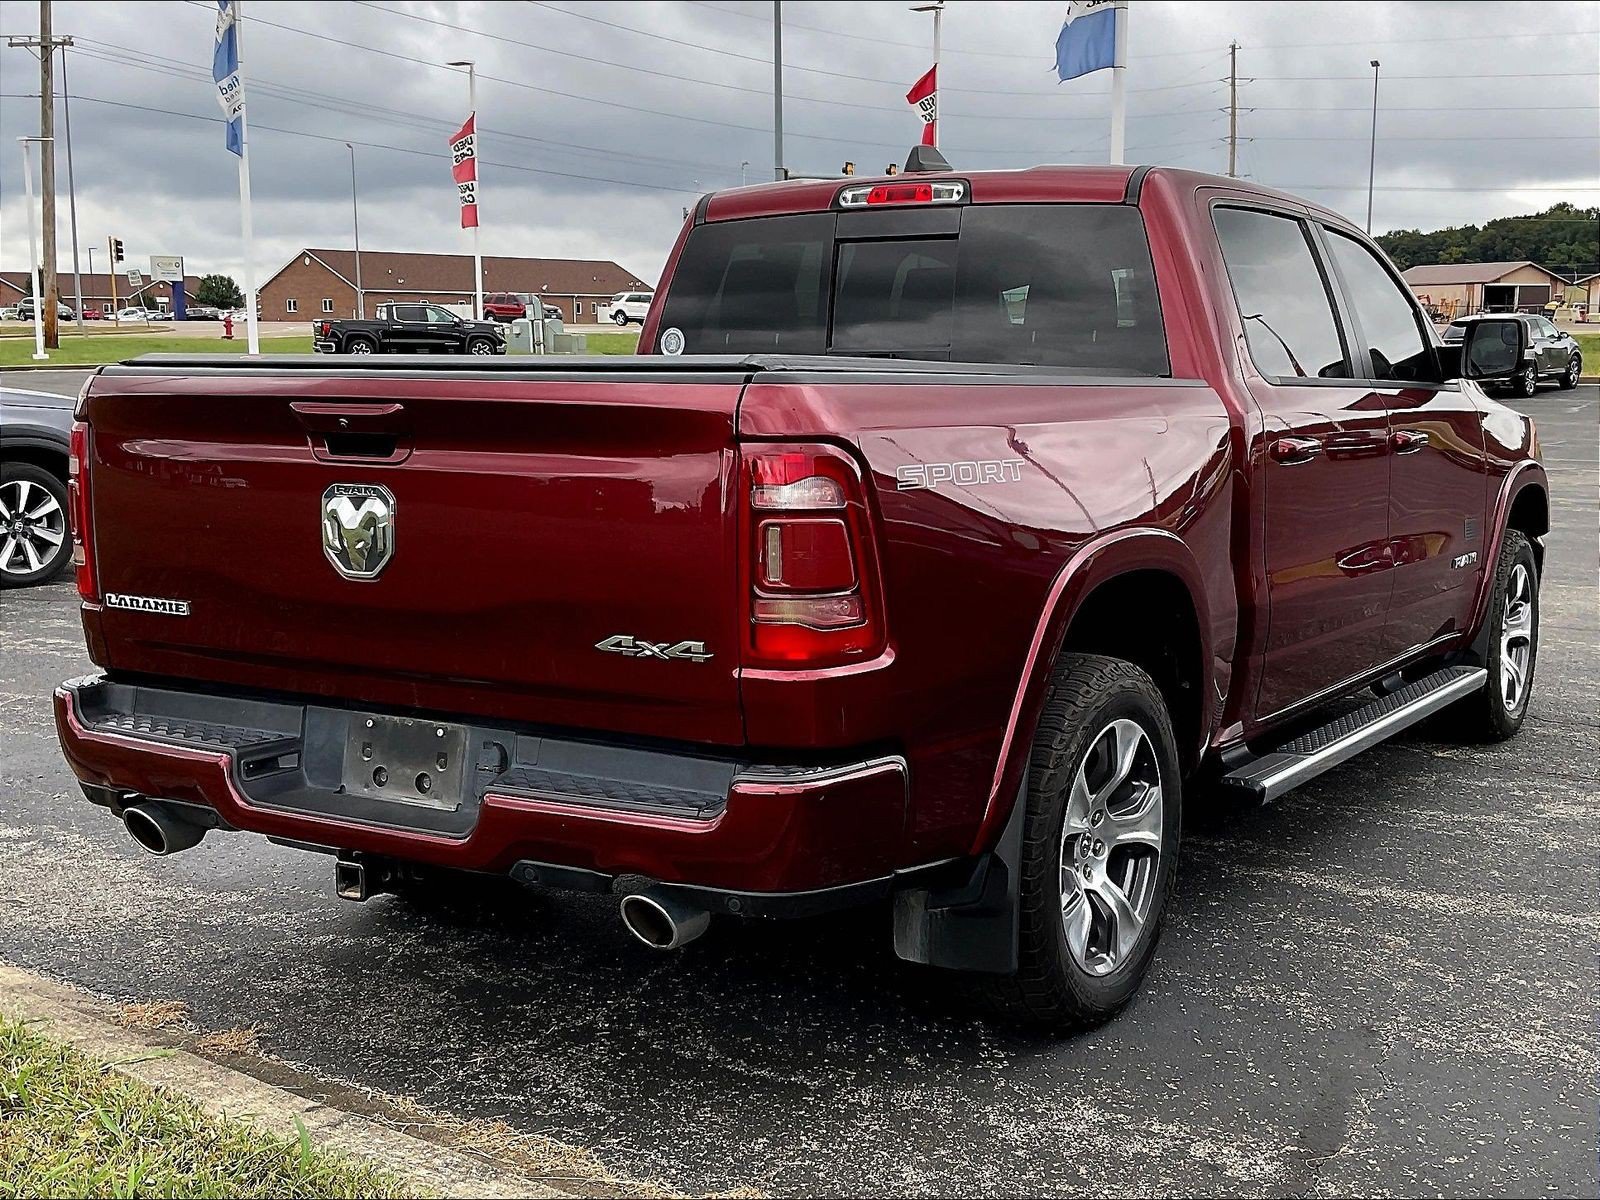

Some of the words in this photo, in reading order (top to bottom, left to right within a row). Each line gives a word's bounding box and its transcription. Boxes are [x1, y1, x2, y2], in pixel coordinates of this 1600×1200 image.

[897, 459, 1025, 490] SPORT
[334, 486, 377, 496] RAM
[106, 593, 188, 615] LARAMIE
